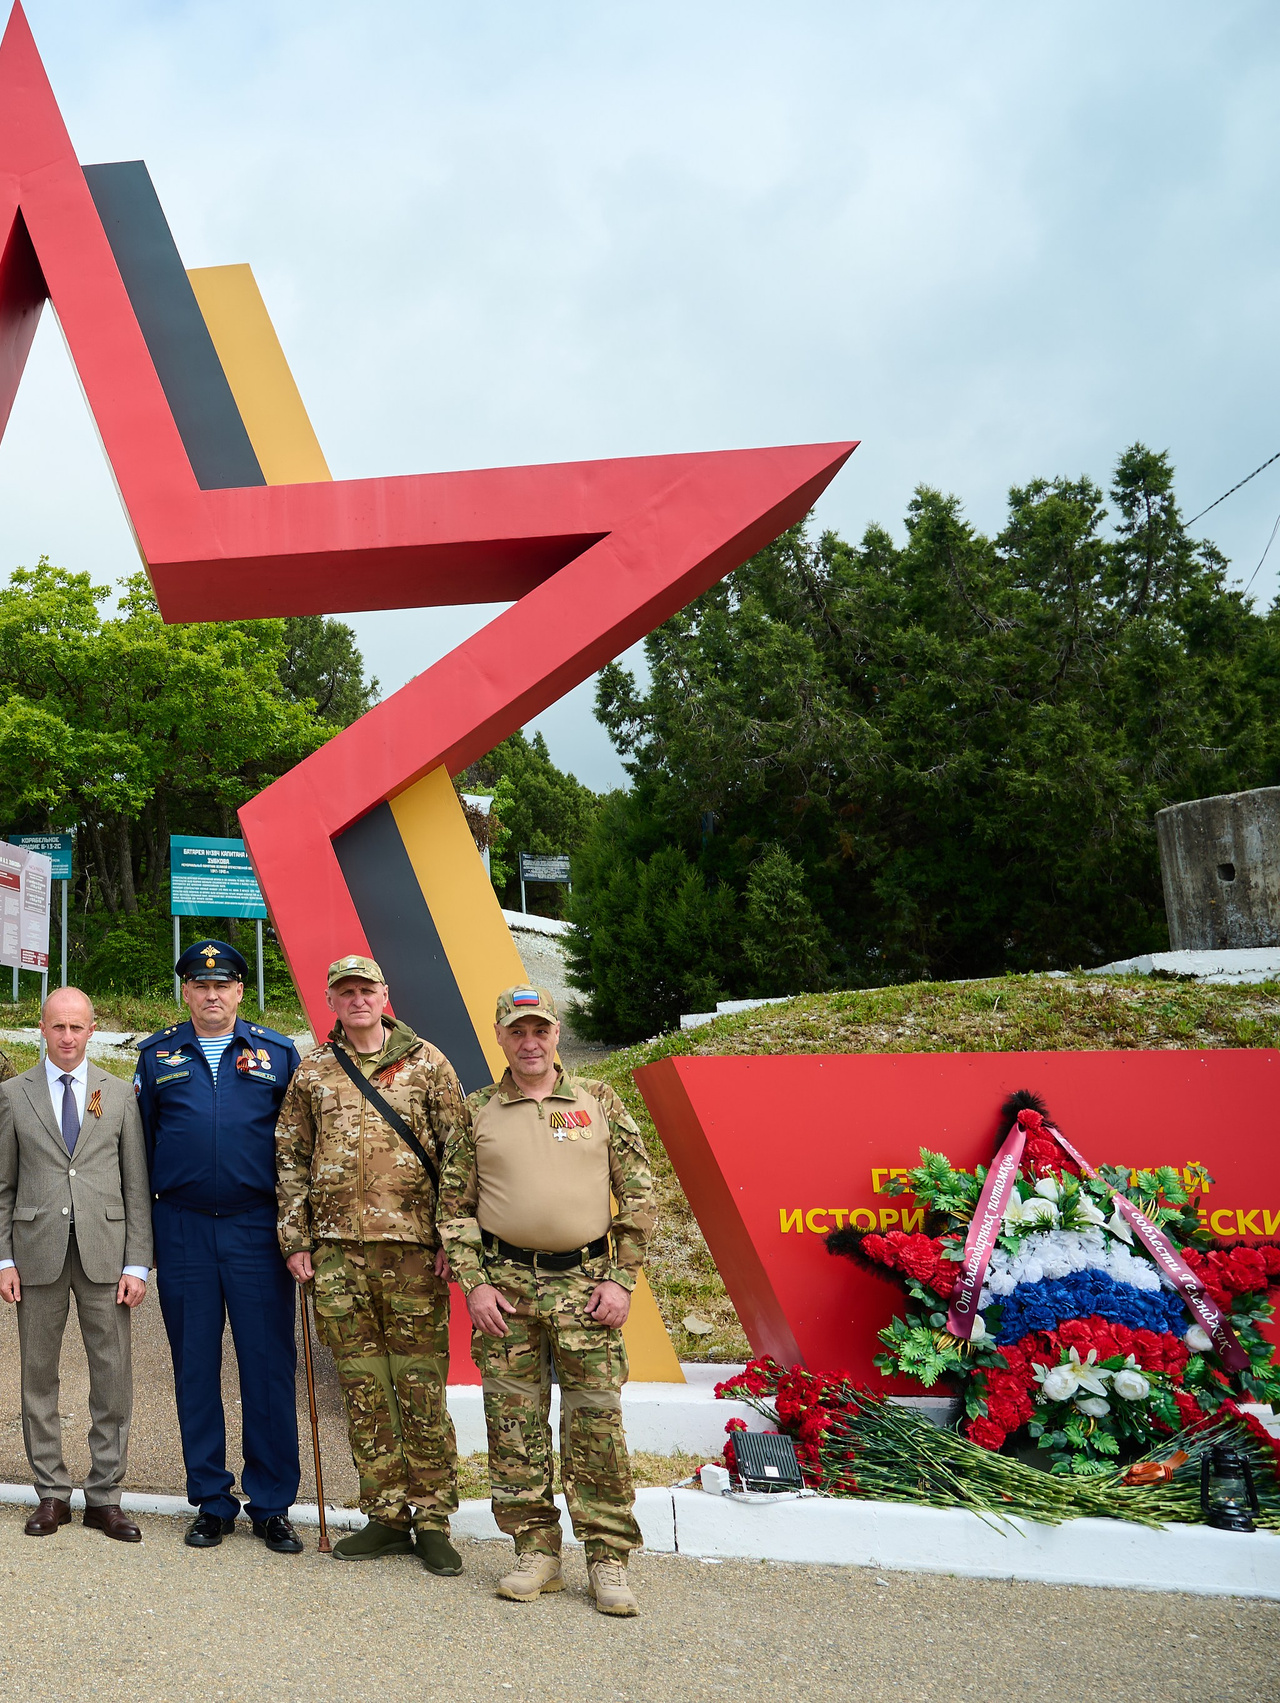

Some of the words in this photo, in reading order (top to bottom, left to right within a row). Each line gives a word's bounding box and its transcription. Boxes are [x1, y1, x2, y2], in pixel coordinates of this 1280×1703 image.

[220, 850, 246, 858] КАПИТАНА
[346, 958, 358, 969] Z
[988, 1153, 1015, 1213] потомков
[962, 1210, 999, 1288] благодарных
[955, 1290, 972, 1314] От
[1130, 1212, 1182, 1273] доблести
[1178, 1273, 1232, 1355] Геленджик
